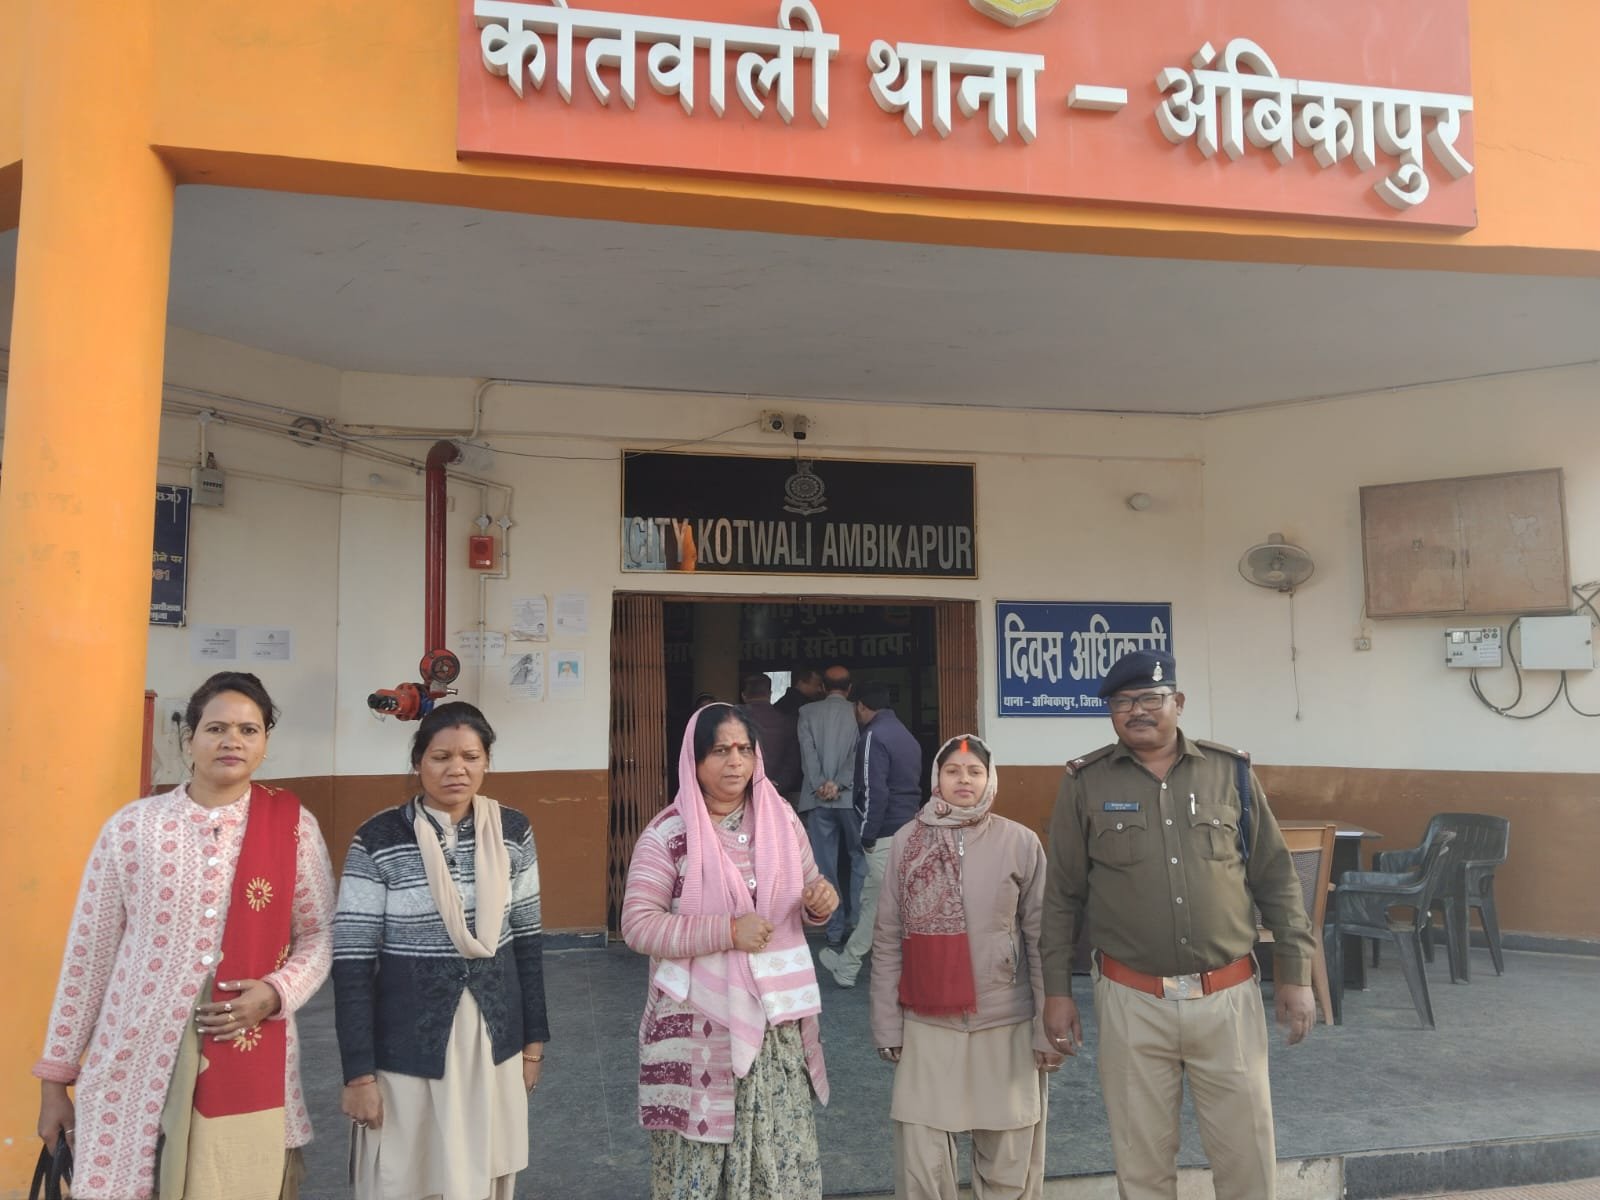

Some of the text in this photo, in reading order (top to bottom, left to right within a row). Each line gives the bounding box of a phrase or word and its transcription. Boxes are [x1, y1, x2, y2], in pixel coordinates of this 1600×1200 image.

[474, 0, 840, 129] कोतवाली
[866, 39, 1045, 145] थाना
[1154, 38, 1473, 210] अंबिकापुर
[628, 516, 973, 570] CITY KOTWALI AMBIKAPUR
[1004, 612, 1064, 685] दिवस
[1003, 696, 1024, 708] थाना
